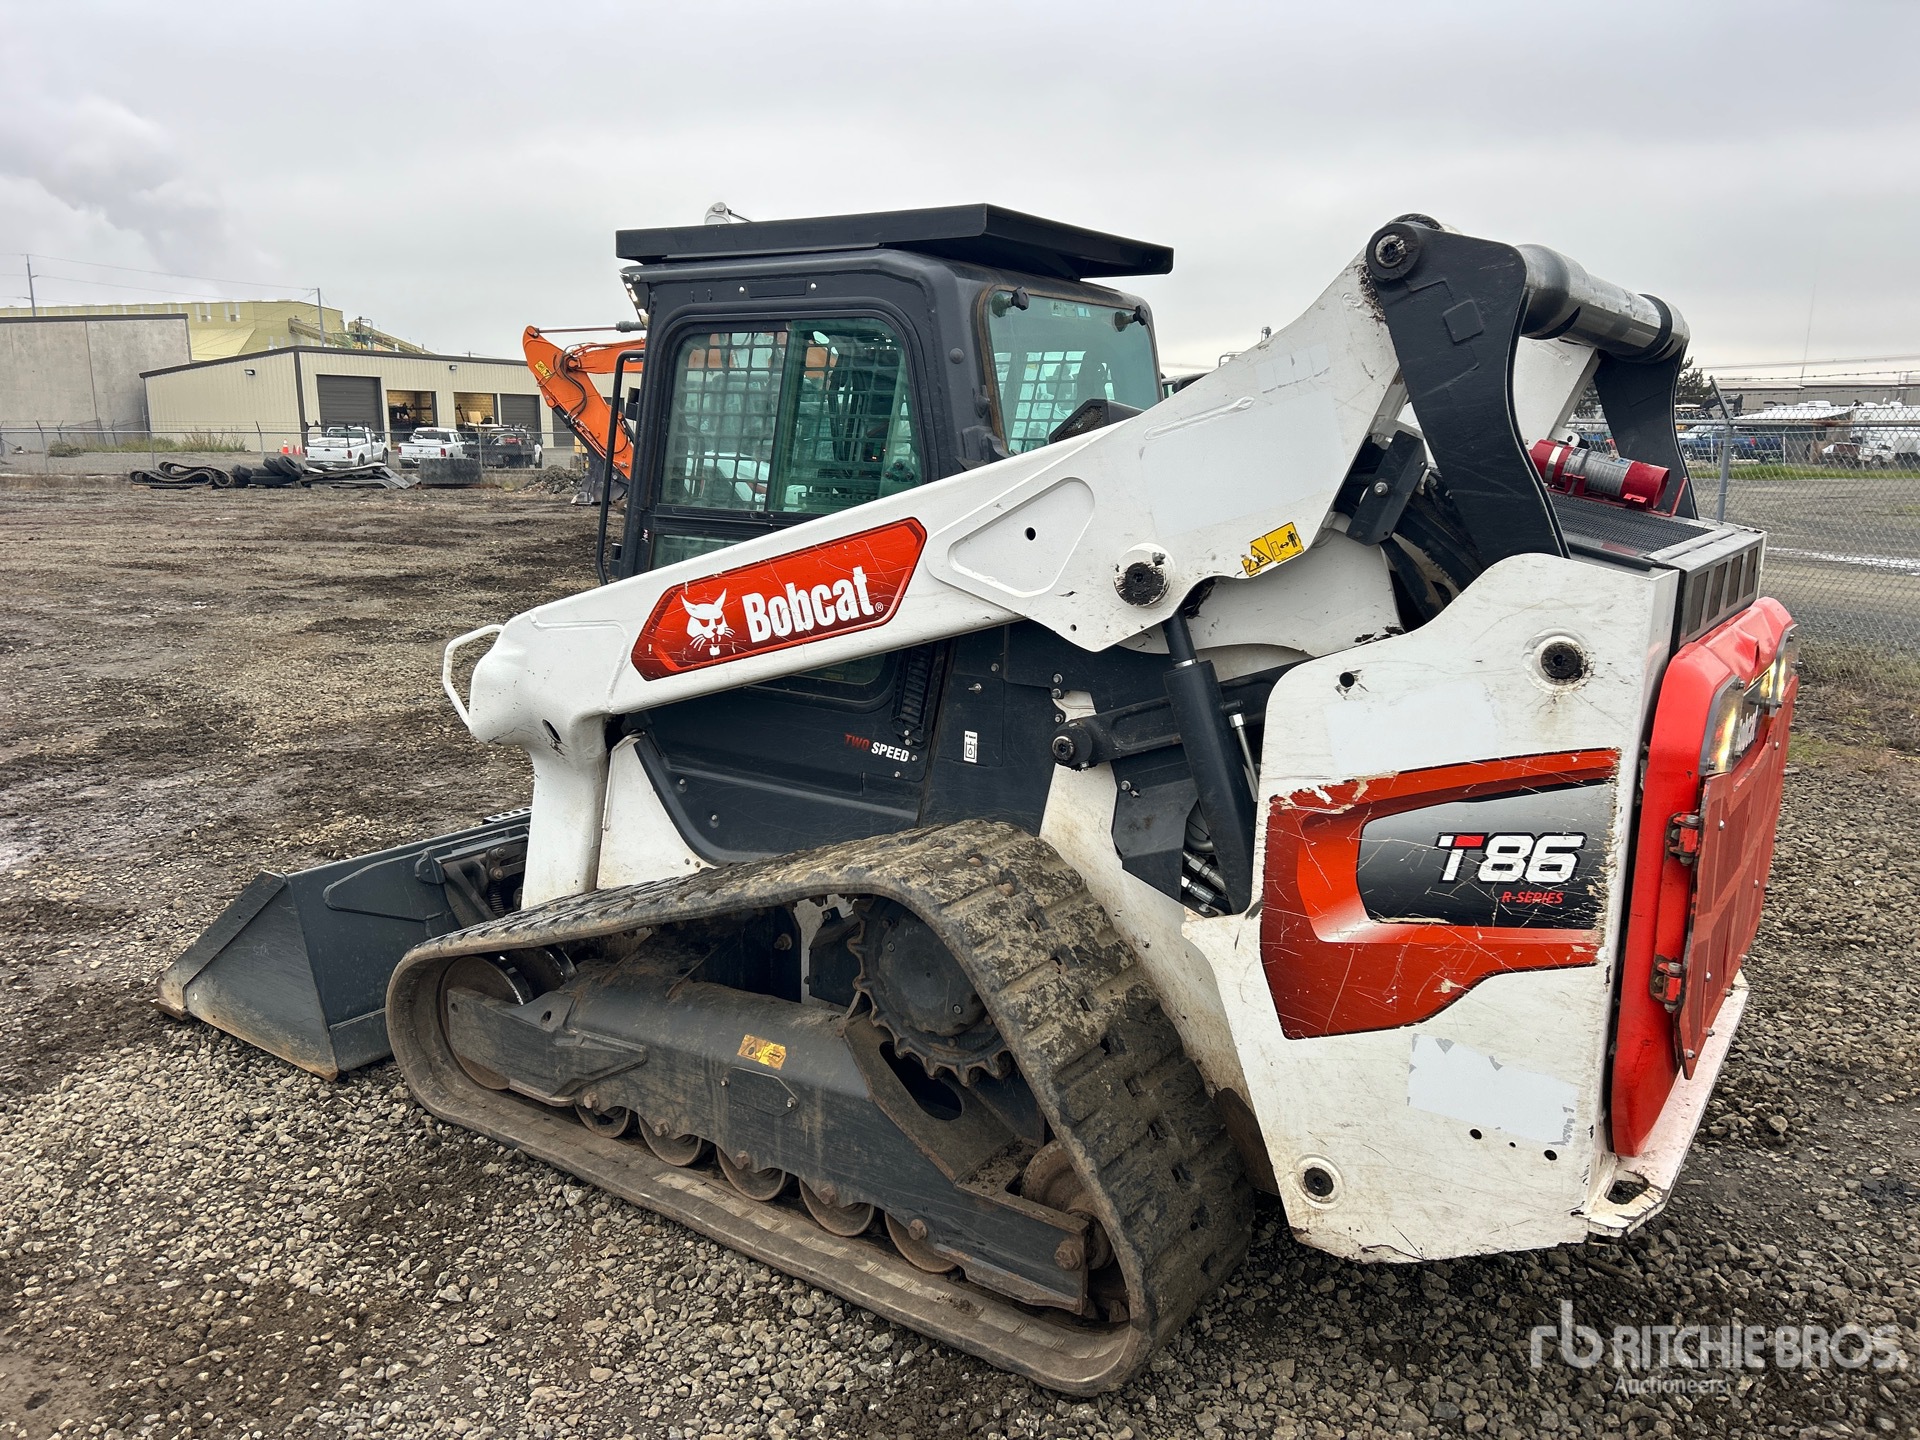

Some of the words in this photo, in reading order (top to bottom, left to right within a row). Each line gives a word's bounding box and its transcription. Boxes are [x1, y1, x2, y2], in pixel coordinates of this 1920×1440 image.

[742, 566, 875, 644] Bobcat
[845, 733, 870, 751] TWO
[871, 741, 910, 763] SPEED
[1437, 833, 1586, 883] T86
[1501, 891, 1565, 905] R-SERIES
